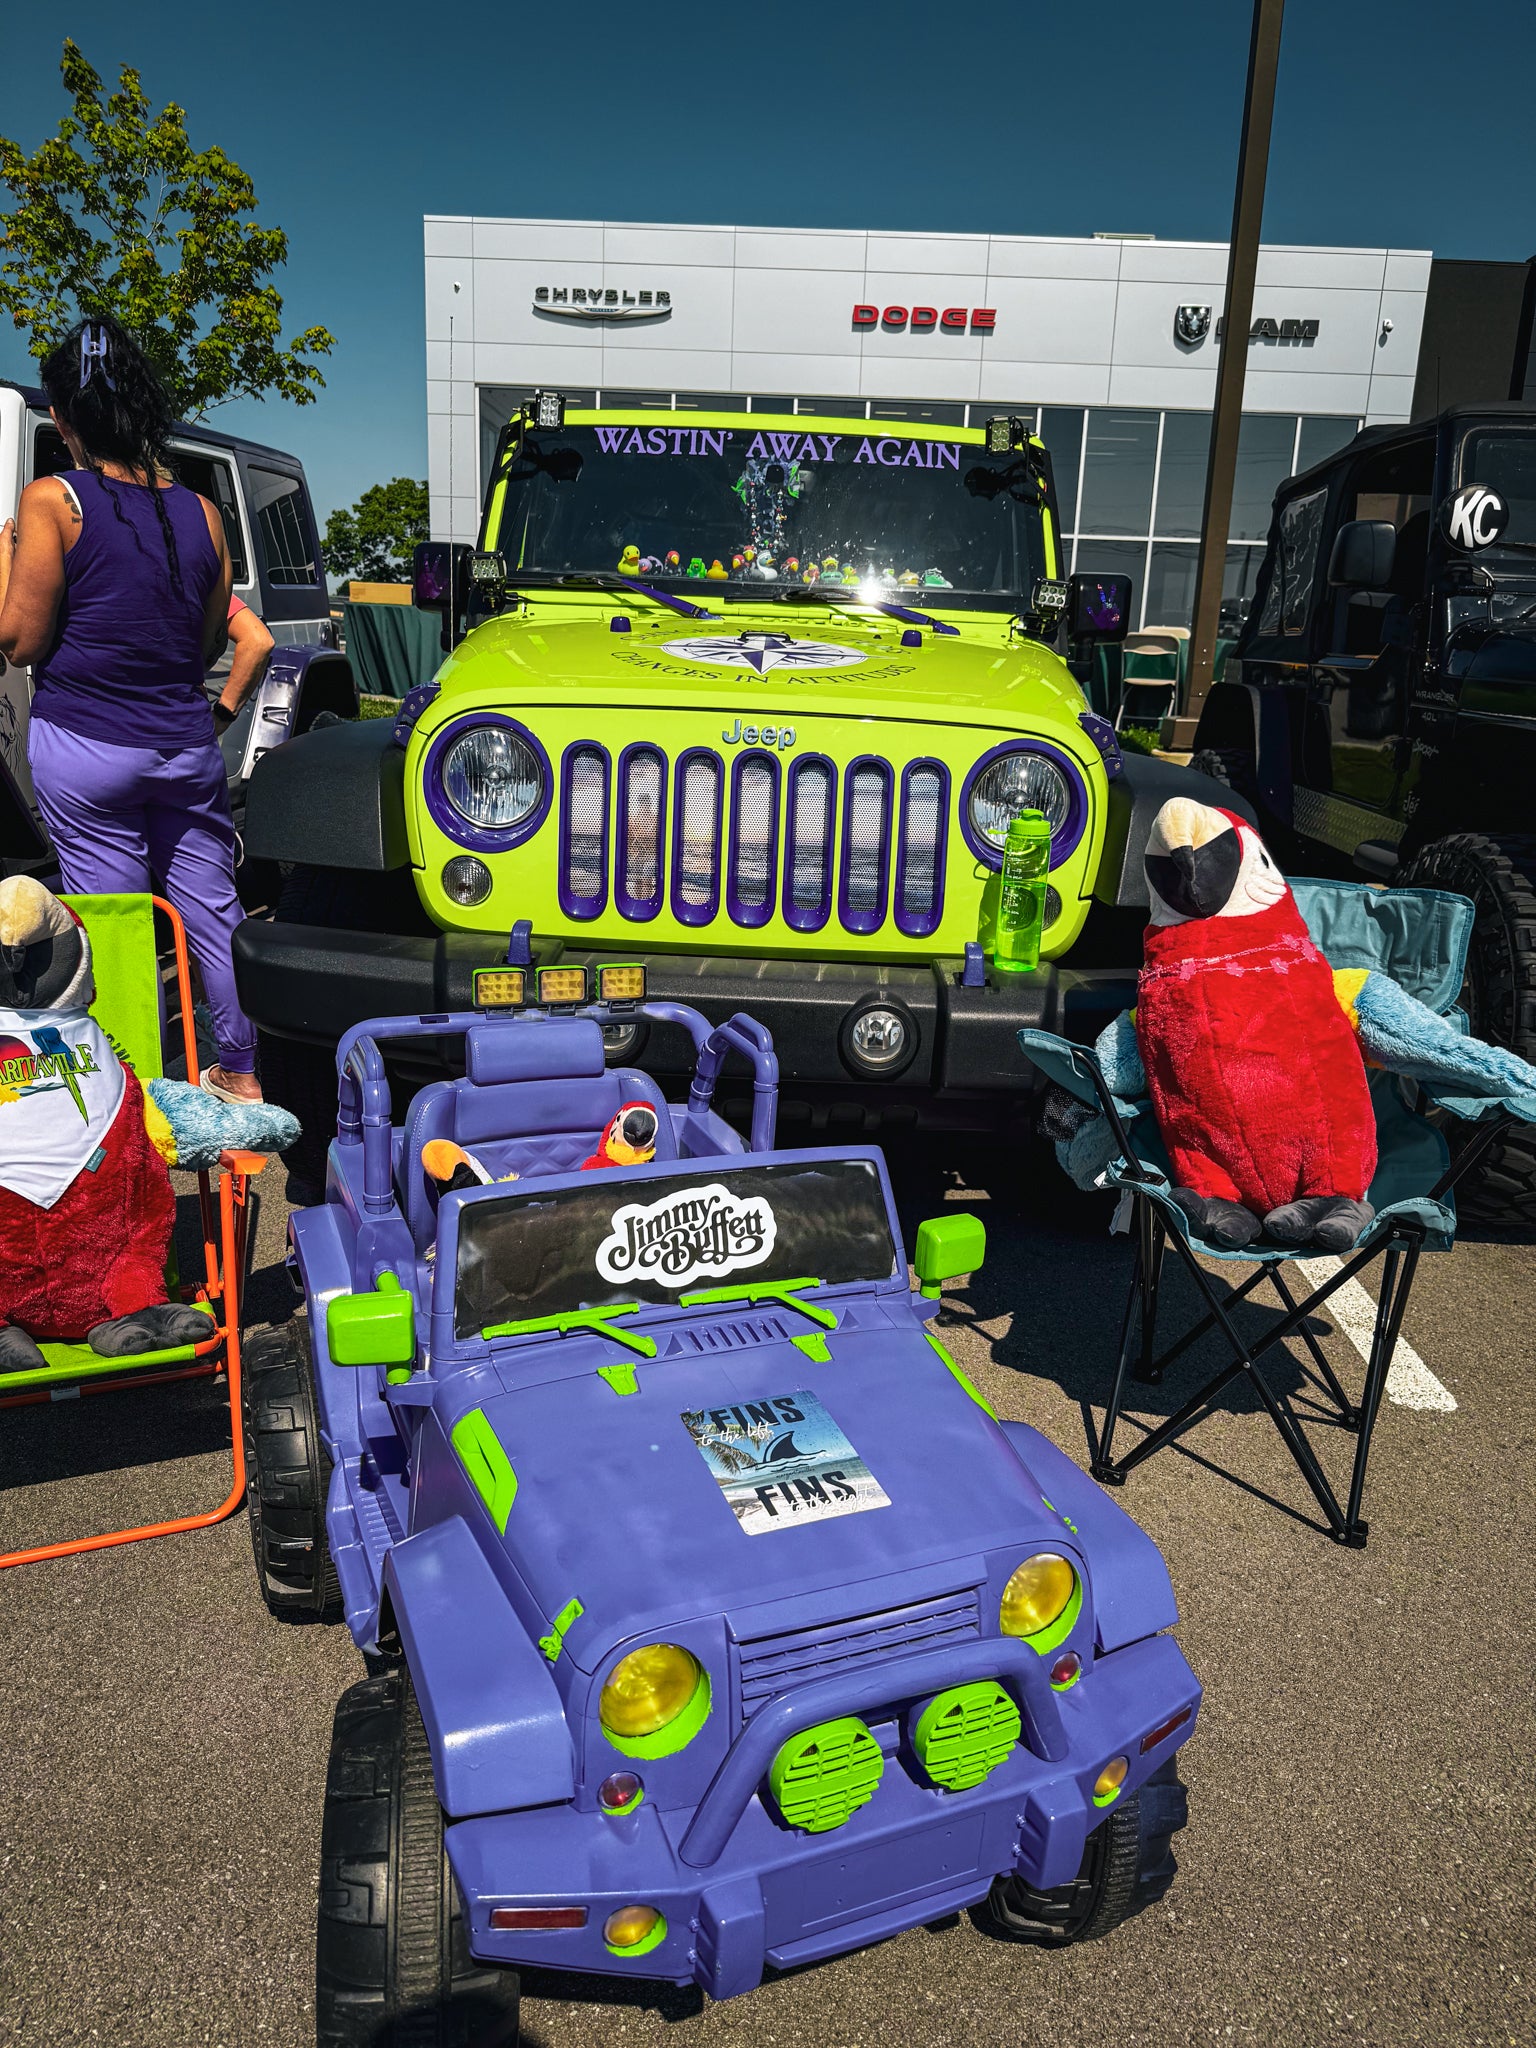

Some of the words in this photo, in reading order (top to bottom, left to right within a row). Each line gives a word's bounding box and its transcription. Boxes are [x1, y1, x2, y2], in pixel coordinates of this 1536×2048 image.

[534, 286, 671, 303] CHRYSLER
[852, 304, 997, 328] DODGE
[1217, 317, 1320, 338] AM
[594, 427, 734, 457] WASTIN'
[745, 432, 842, 462] AWAY
[853, 437, 962, 471] AGAIN
[1449, 490, 1502, 548] KC
[611, 651, 723, 680] CHANGES
[735, 675, 769, 684] IN
[722, 719, 797, 751] Jeep
[607, 1195, 721, 1271] Jimmy
[638, 1206, 767, 1275] Buffett
[708, 1397, 806, 1434] FINS
[719, 1426, 742, 1445] the
[754, 1470, 857, 1517] FINS
